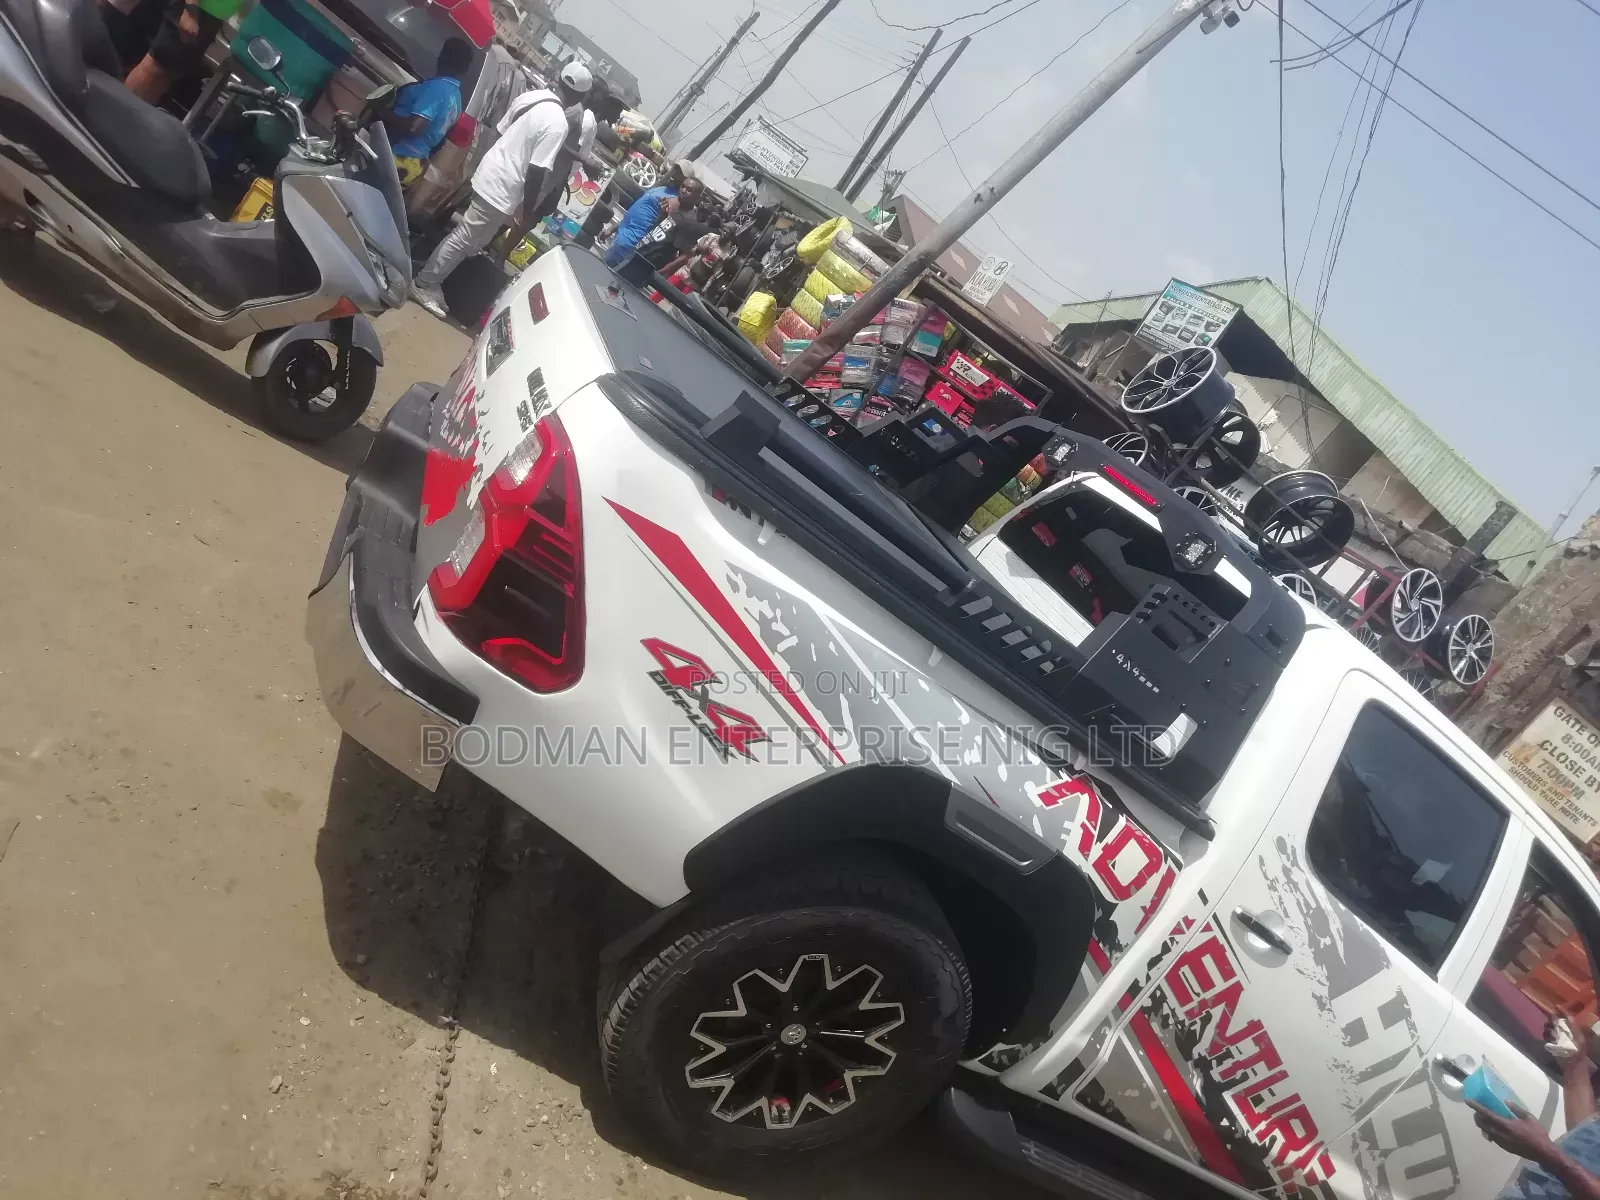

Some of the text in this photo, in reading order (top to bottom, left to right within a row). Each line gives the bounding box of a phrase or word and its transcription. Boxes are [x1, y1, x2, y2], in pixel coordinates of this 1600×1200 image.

[761, 147, 786, 167] HYUNDAI
[1554, 706, 1588, 735] GATE
[1537, 758, 1586, 801] 7:00PM
[1541, 739, 1587, 779] CLOSE
[1502, 750, 1598, 827] CUSTOMERS AND TENANTS
[1508, 766, 1581, 825] SHOULD TAKE NOTE
